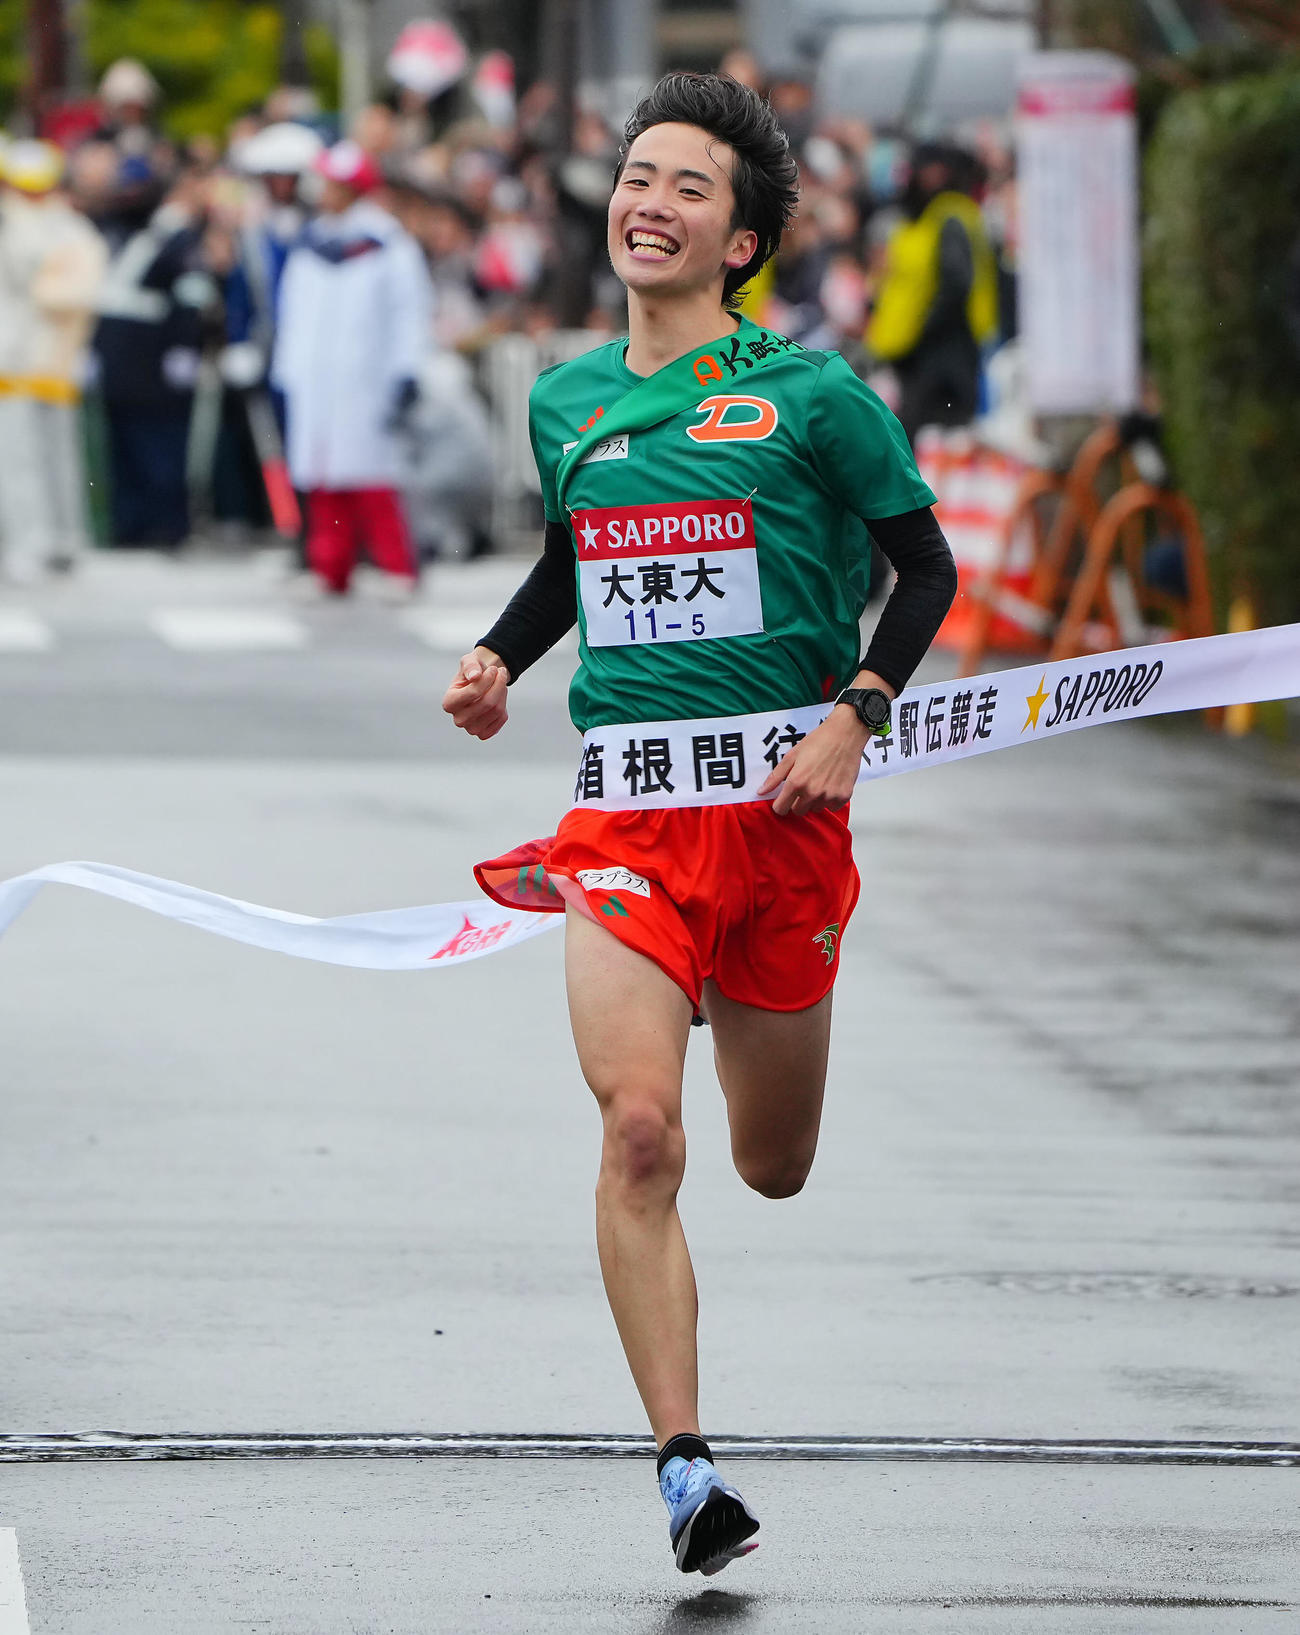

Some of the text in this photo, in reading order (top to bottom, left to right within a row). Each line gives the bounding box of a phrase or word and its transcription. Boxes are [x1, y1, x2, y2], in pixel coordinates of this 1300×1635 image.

[686, 395, 778, 443] D
[607, 512, 745, 549] SAPPORO
[601, 558, 726, 608] 大東大
[1046, 661, 1164, 728] SAPPORO
